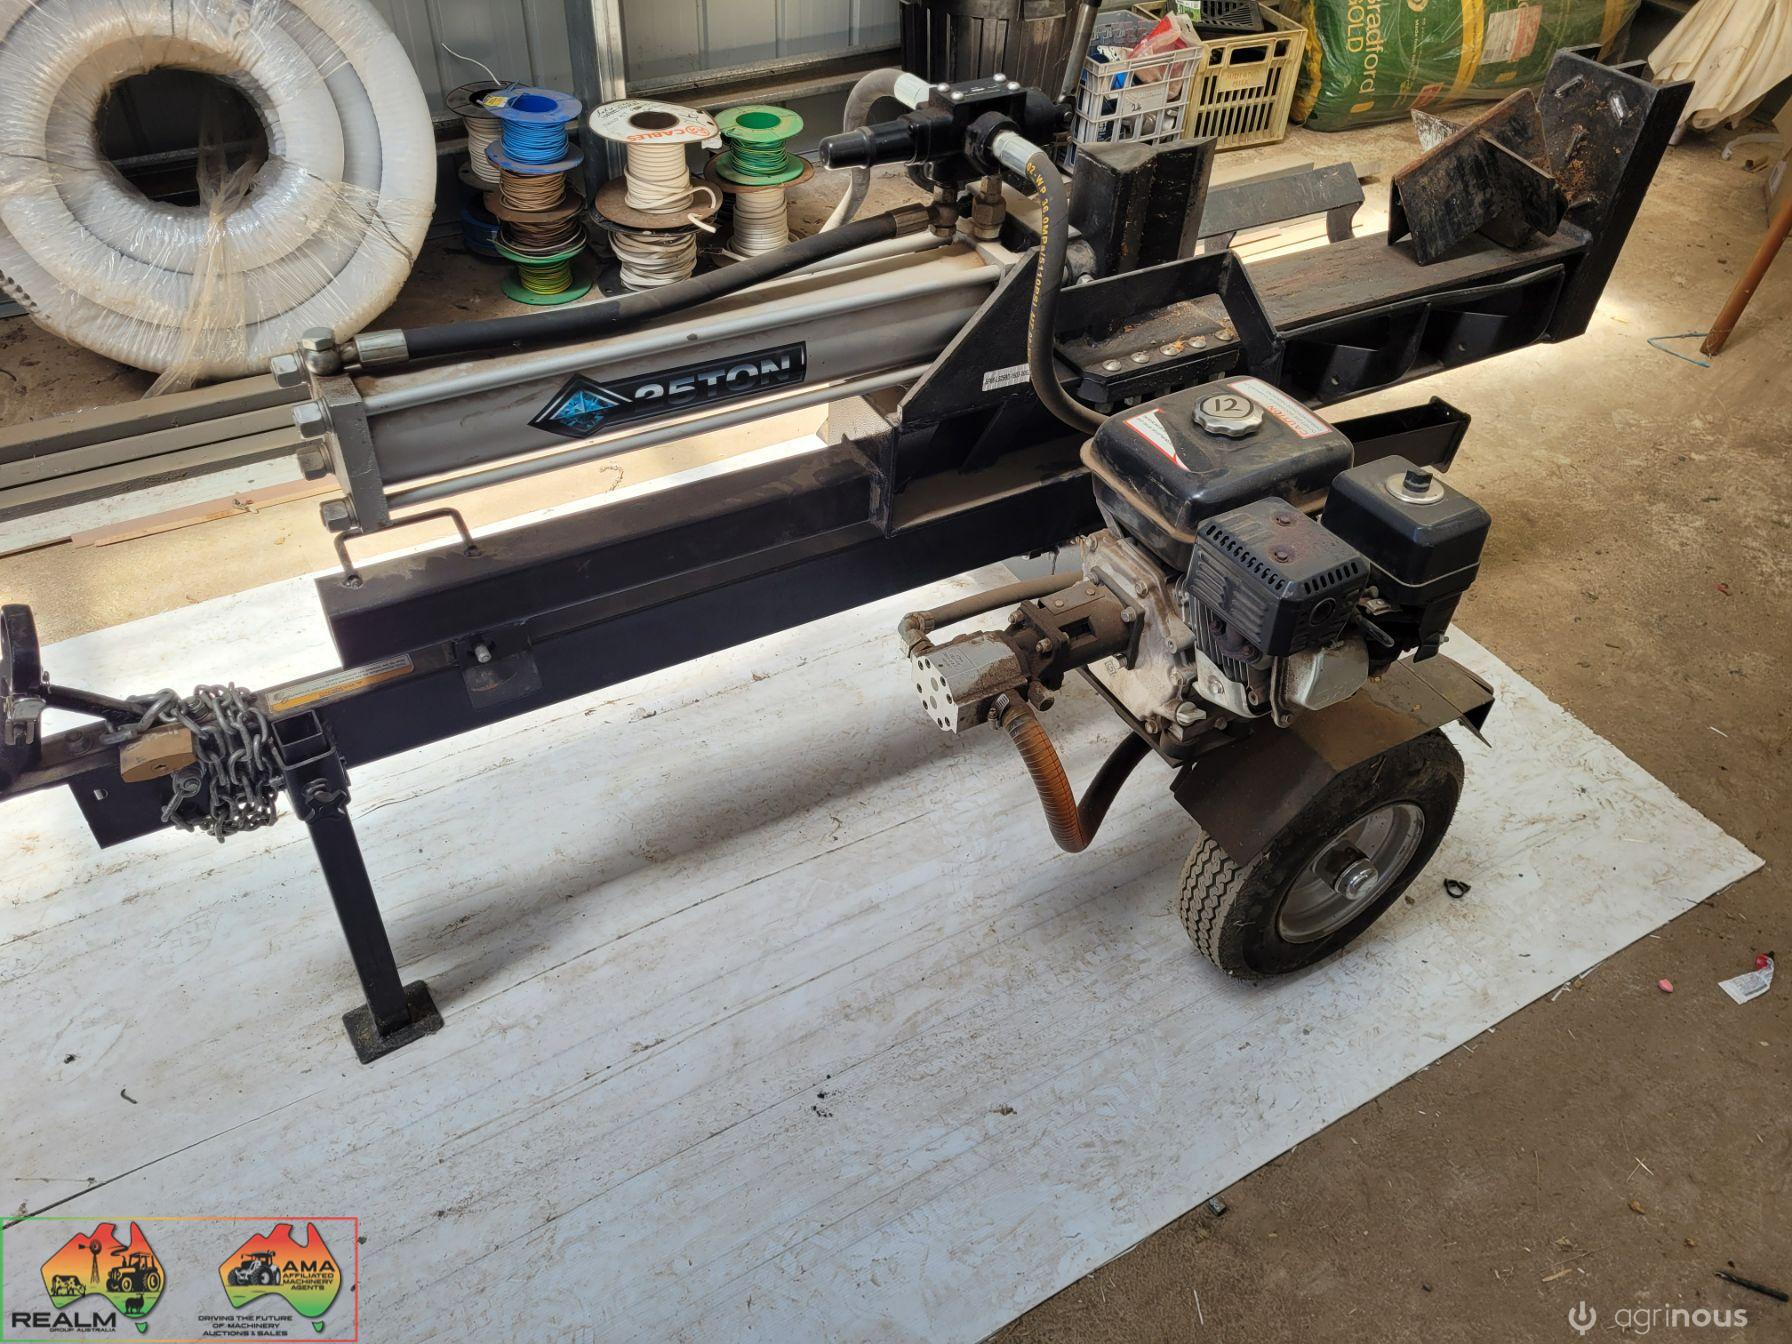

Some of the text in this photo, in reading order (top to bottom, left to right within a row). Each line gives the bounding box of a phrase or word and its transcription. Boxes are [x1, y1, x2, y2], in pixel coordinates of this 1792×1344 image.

[1359, 0, 1384, 94] radford
[627, 129, 685, 142] CABLES
[1214, 398, 1242, 412] 12
